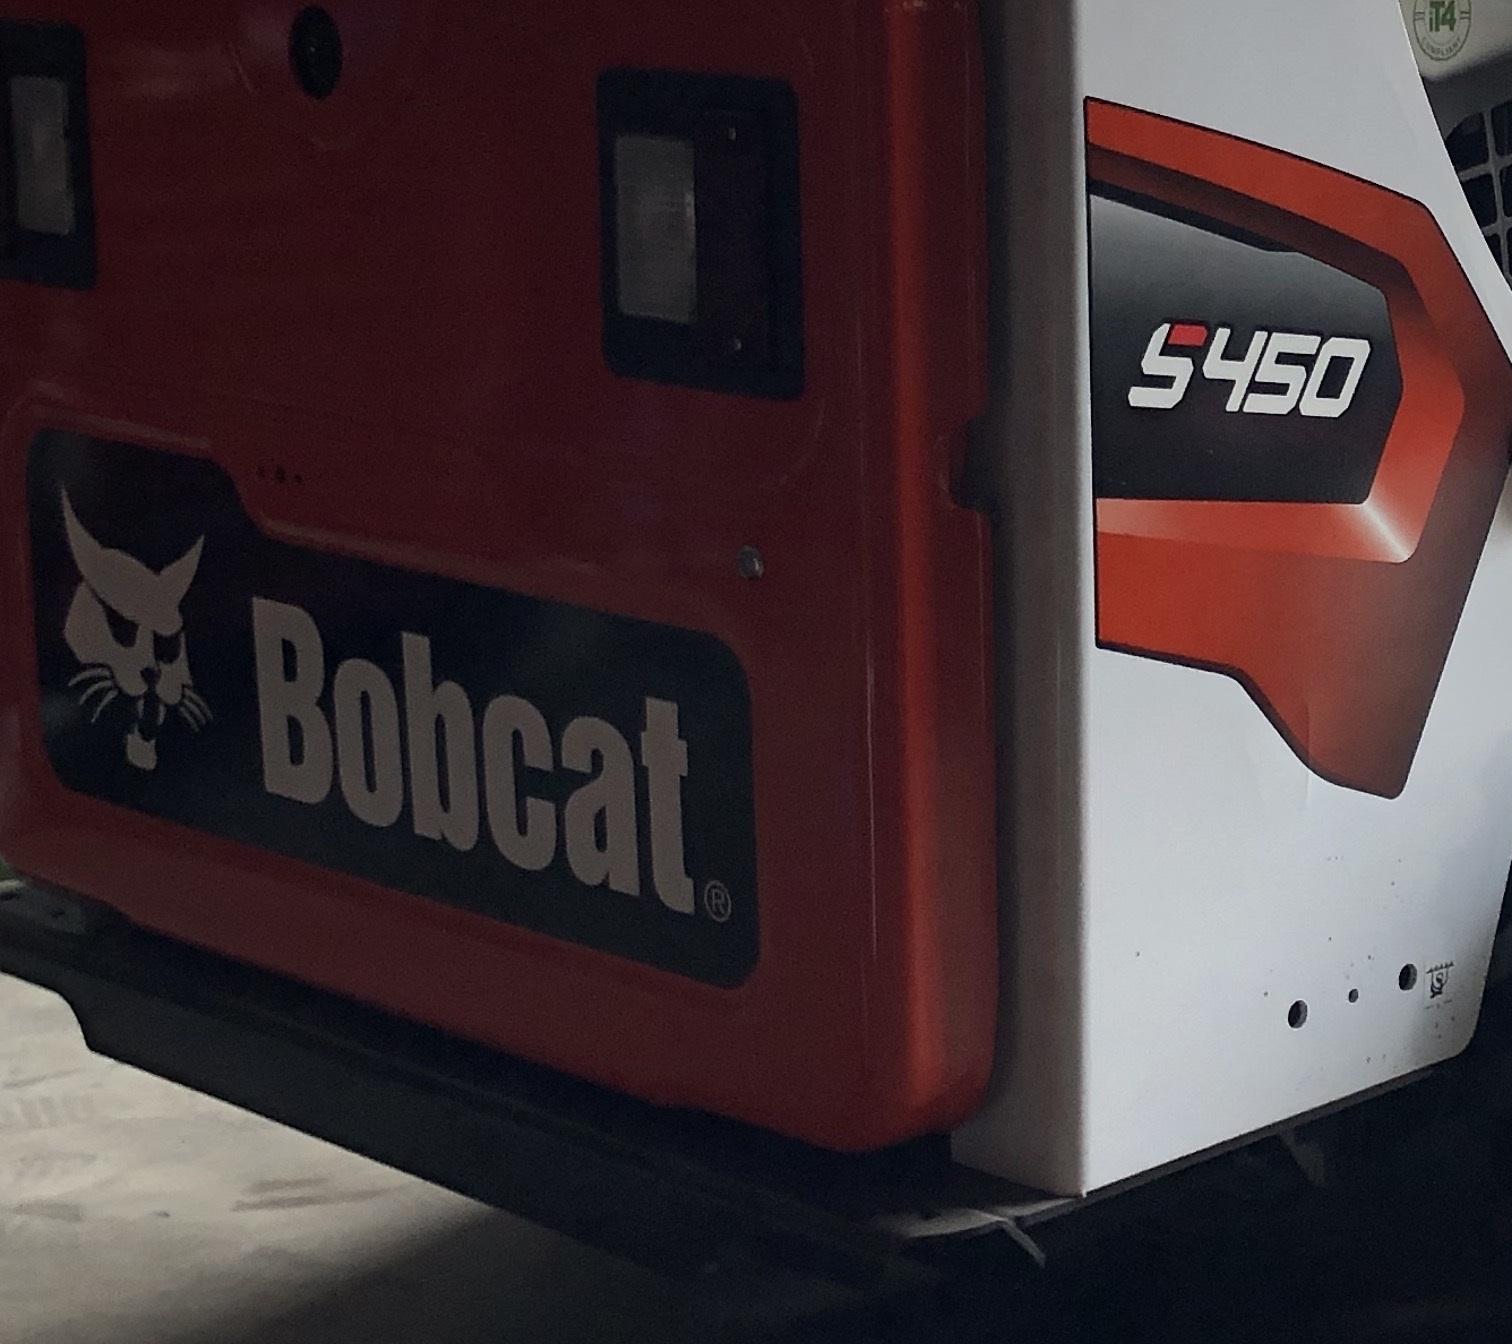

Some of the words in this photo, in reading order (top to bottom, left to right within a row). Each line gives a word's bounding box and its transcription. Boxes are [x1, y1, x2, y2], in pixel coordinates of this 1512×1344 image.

[1429, 0, 1457, 32] iT4
[1128, 322, 1371, 418] S450
[252, 596, 695, 915] Bobcat
